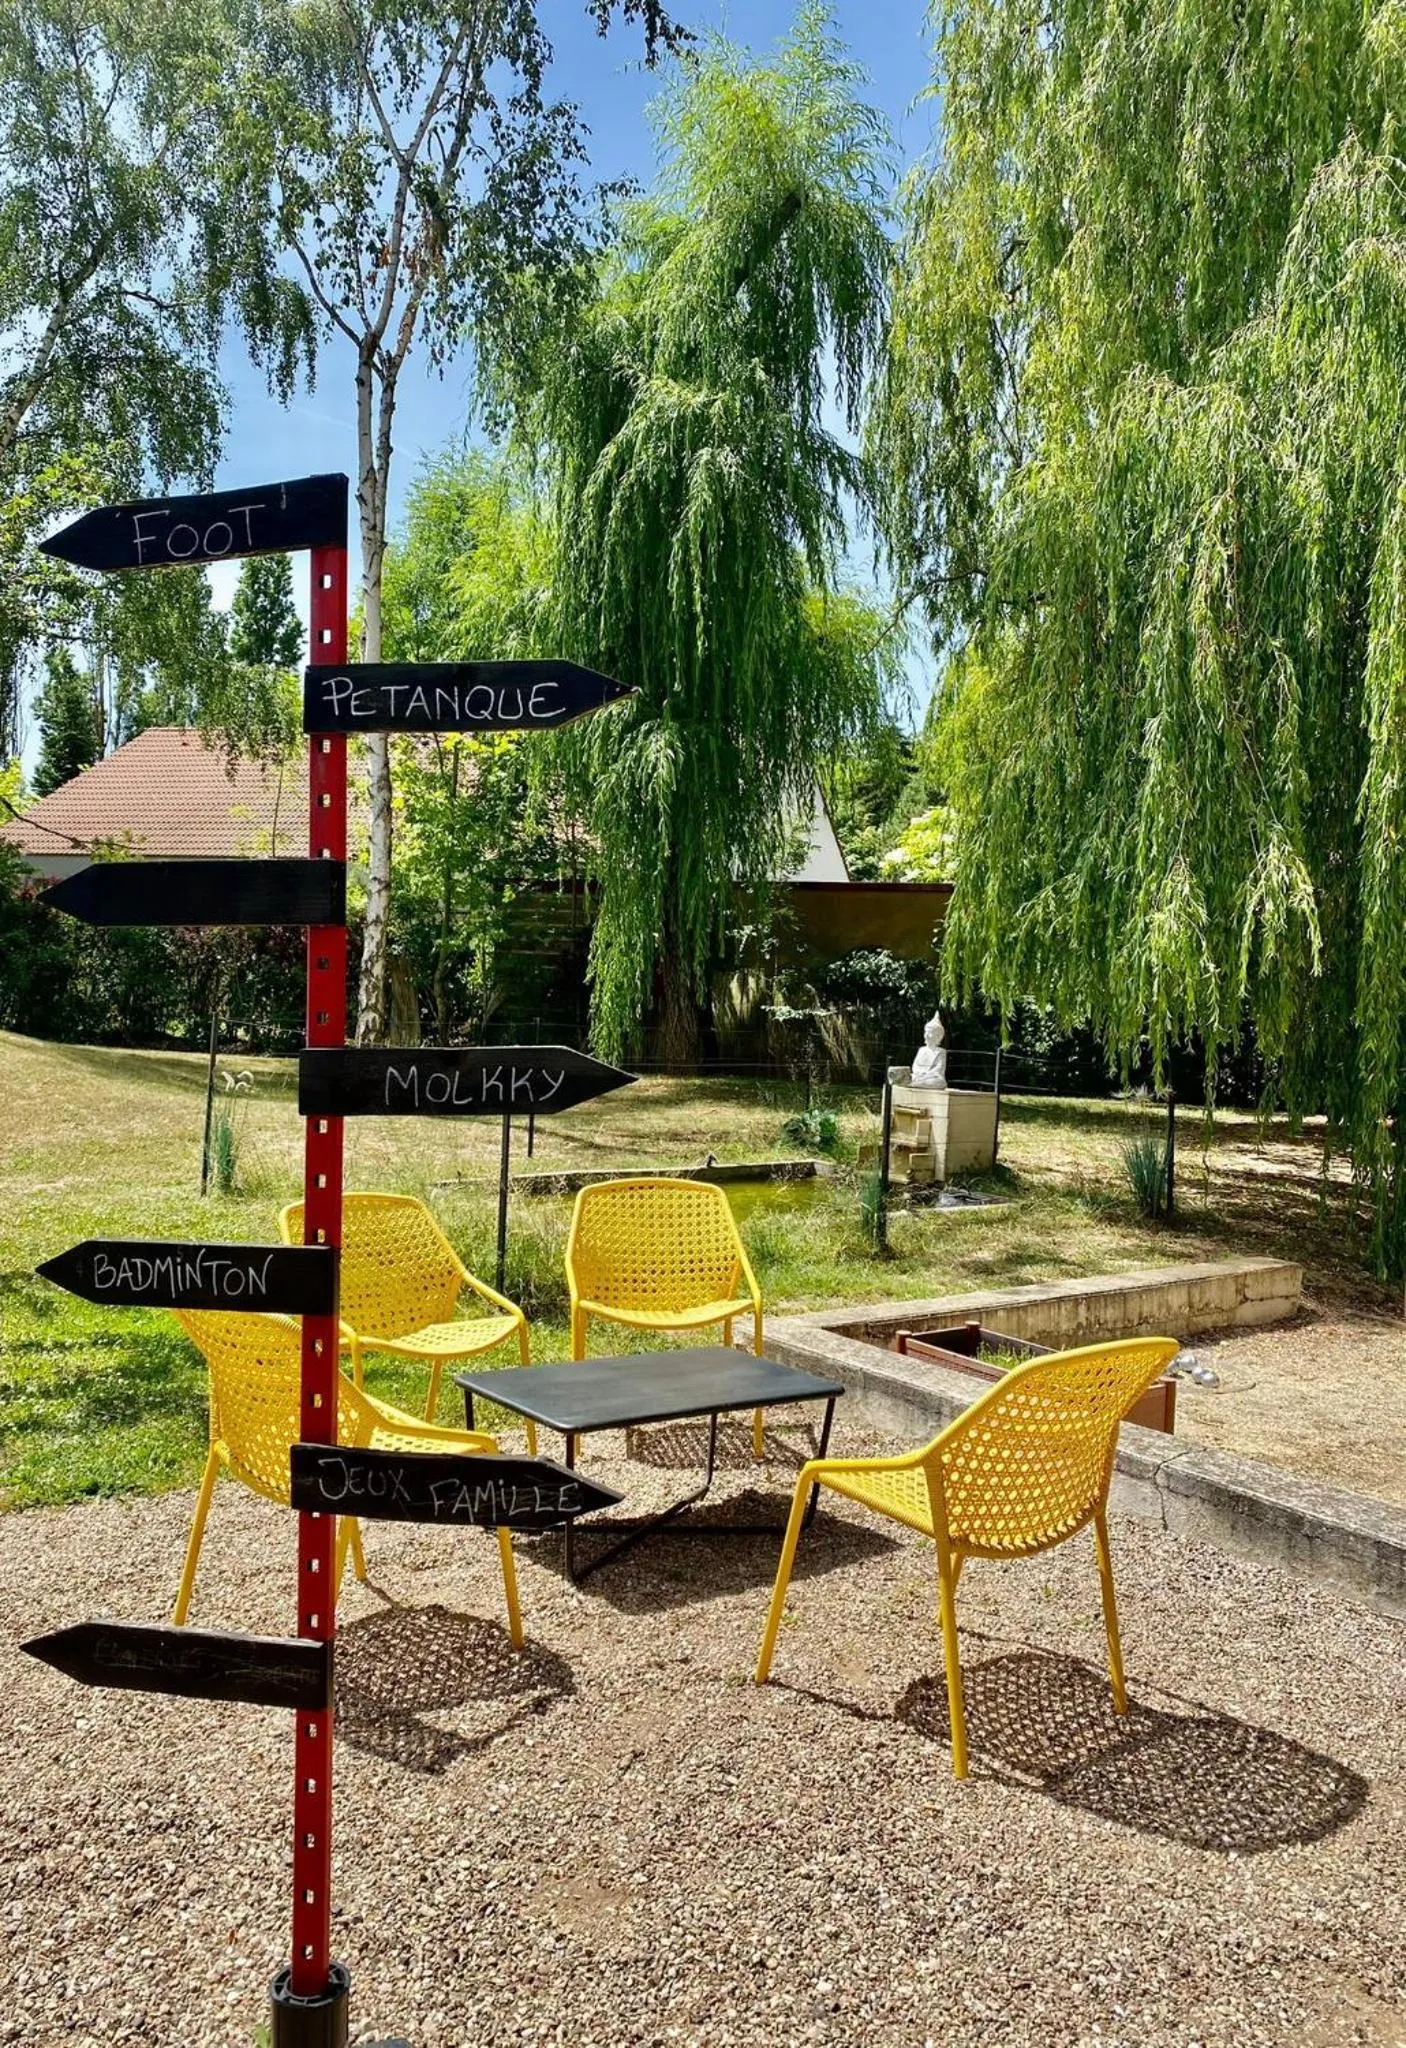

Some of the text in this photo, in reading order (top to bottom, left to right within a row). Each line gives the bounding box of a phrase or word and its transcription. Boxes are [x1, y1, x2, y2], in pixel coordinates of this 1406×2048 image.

[131, 504, 266, 565] FOOT
[320, 674, 567, 721] PETANQUE
[384, 1064, 566, 1108] MOLKKY
[317, 1456, 413, 1500] JEUX
